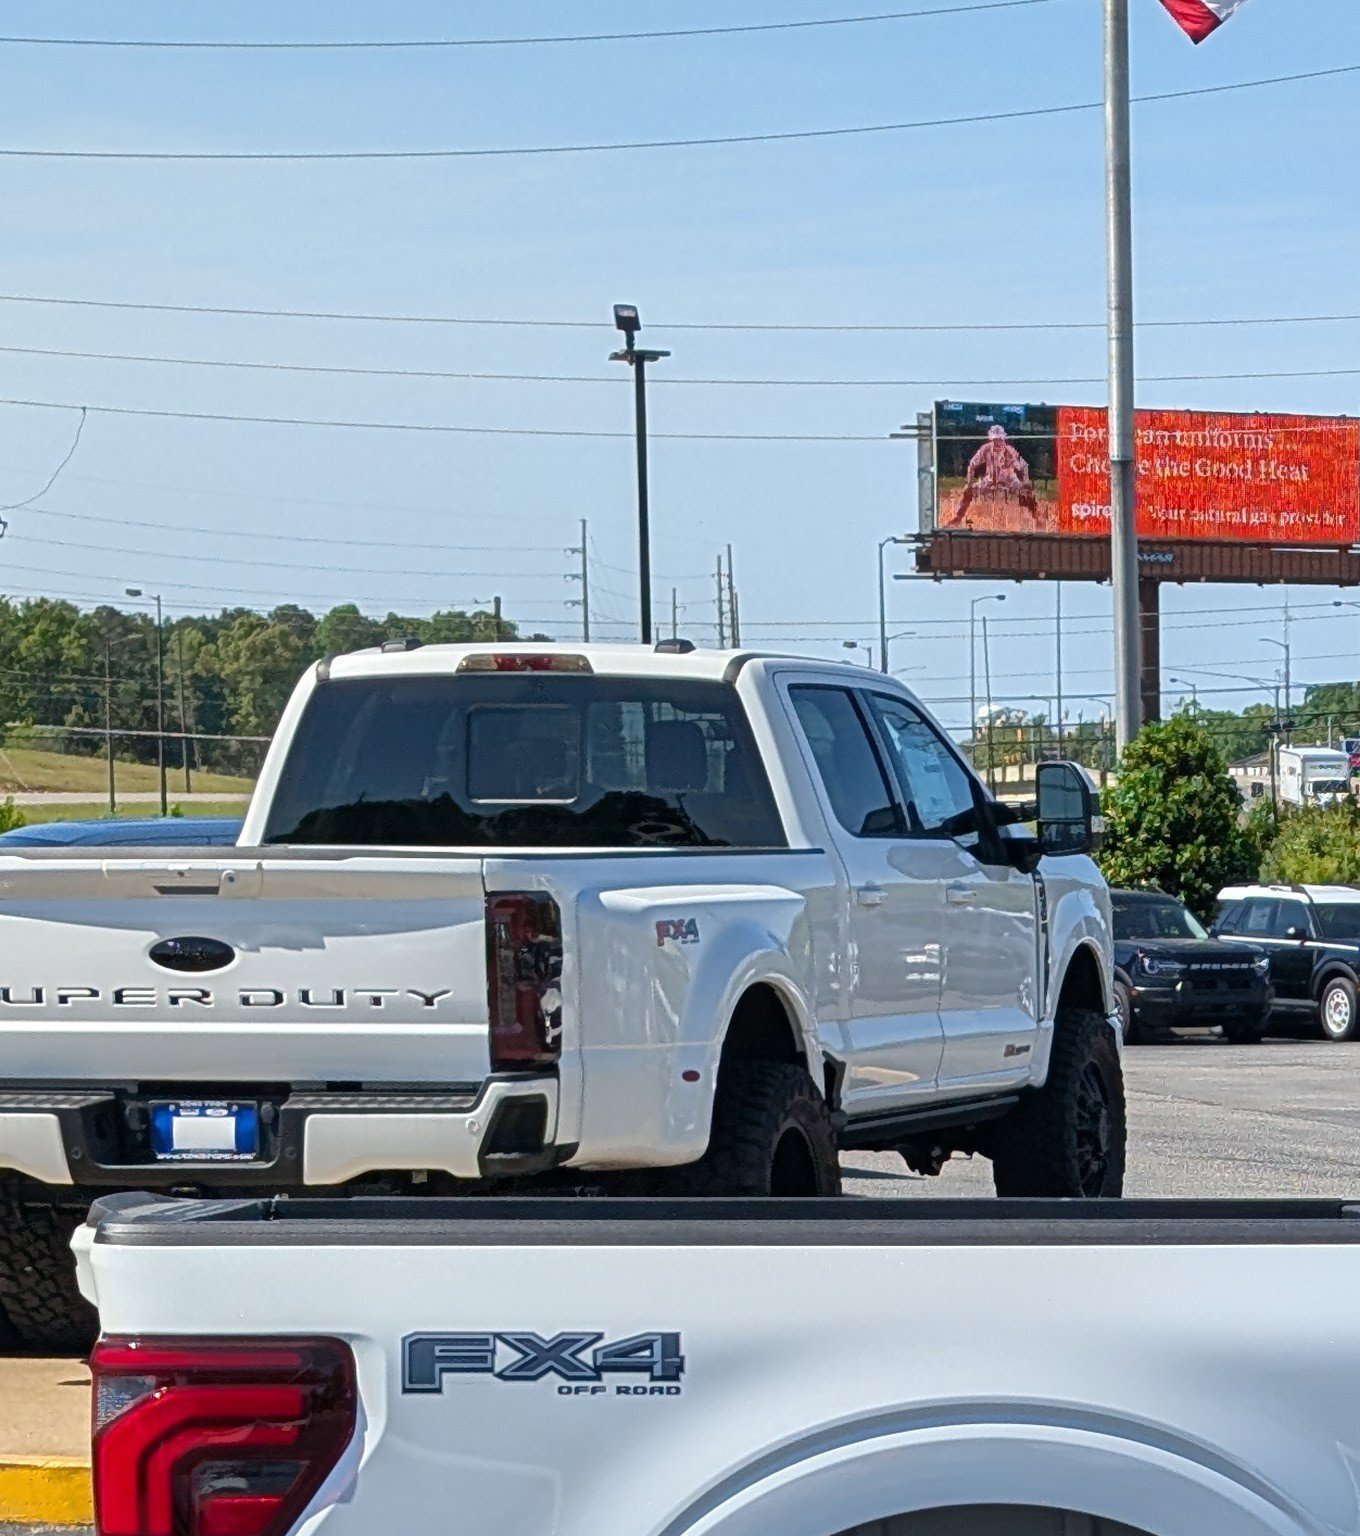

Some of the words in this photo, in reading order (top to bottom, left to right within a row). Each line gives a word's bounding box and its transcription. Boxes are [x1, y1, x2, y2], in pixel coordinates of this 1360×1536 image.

[1070, 422, 1107, 443] For
[1069, 453, 1150, 476] Choe
[1155, 456, 1191, 478] the
[1195, 457, 1252, 480] Good
[1258, 459, 1310, 482] Heat
[239, 987, 455, 1009] DUTY
[400, 1330, 687, 1395] FX4
[557, 1385, 607, 1396] OFF
[616, 1385, 682, 1396] ROAD
